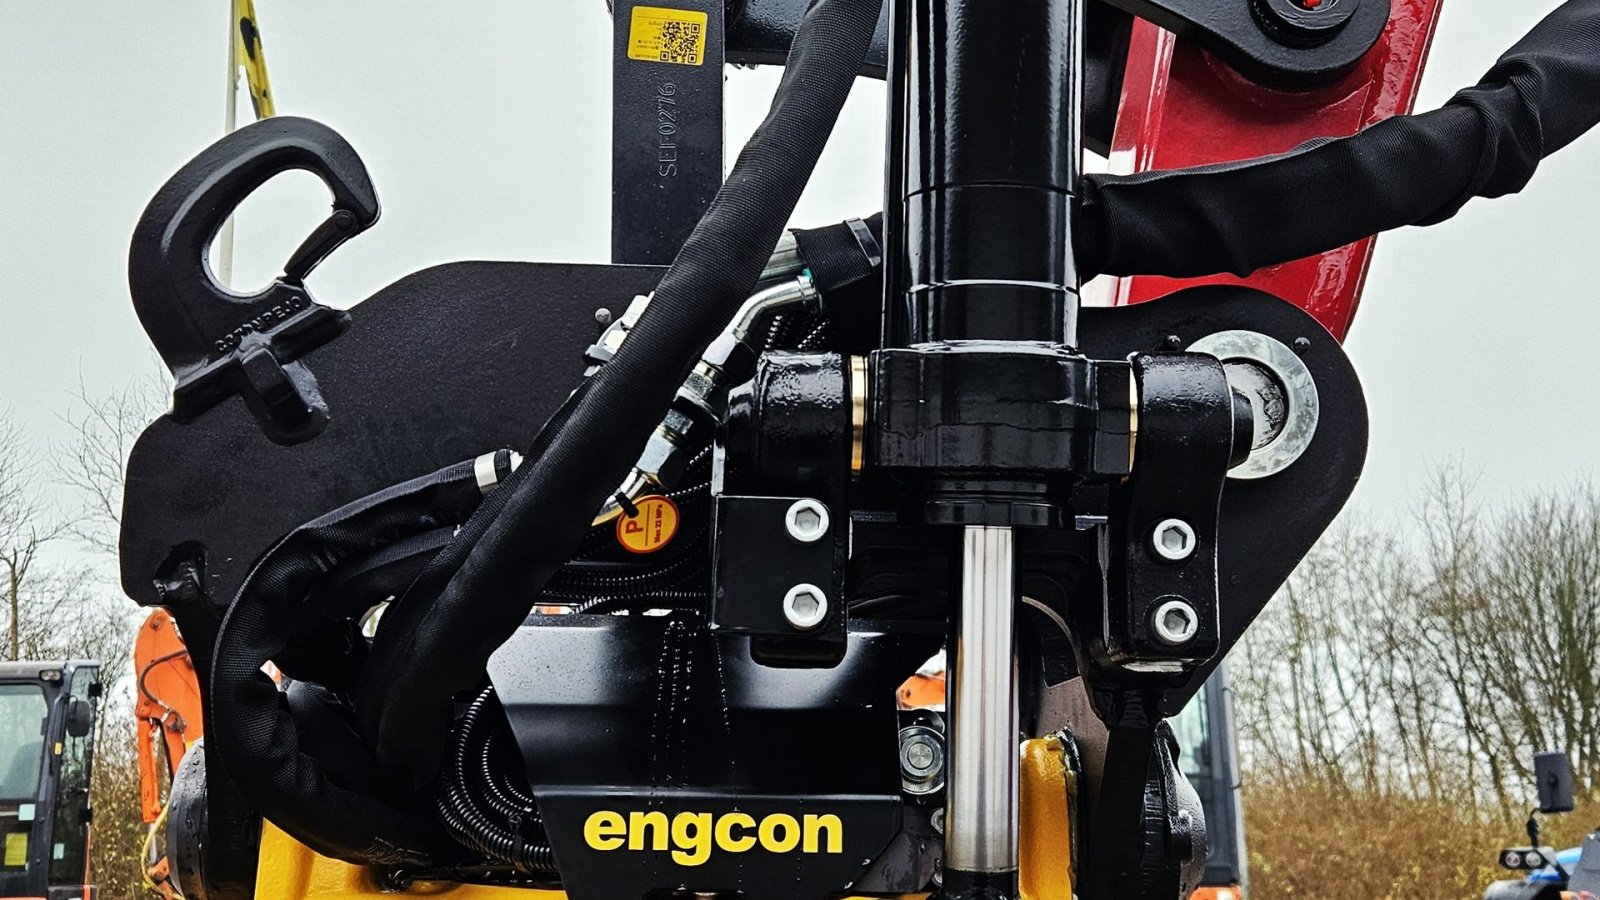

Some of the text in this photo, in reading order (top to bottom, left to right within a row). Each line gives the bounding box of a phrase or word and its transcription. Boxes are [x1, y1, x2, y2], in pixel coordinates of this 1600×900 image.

[658, 83, 677, 177] SEF0276
[626, 520, 644, 534] P
[655, 519, 662, 528] 22
[584, 811, 843, 866] engcon
